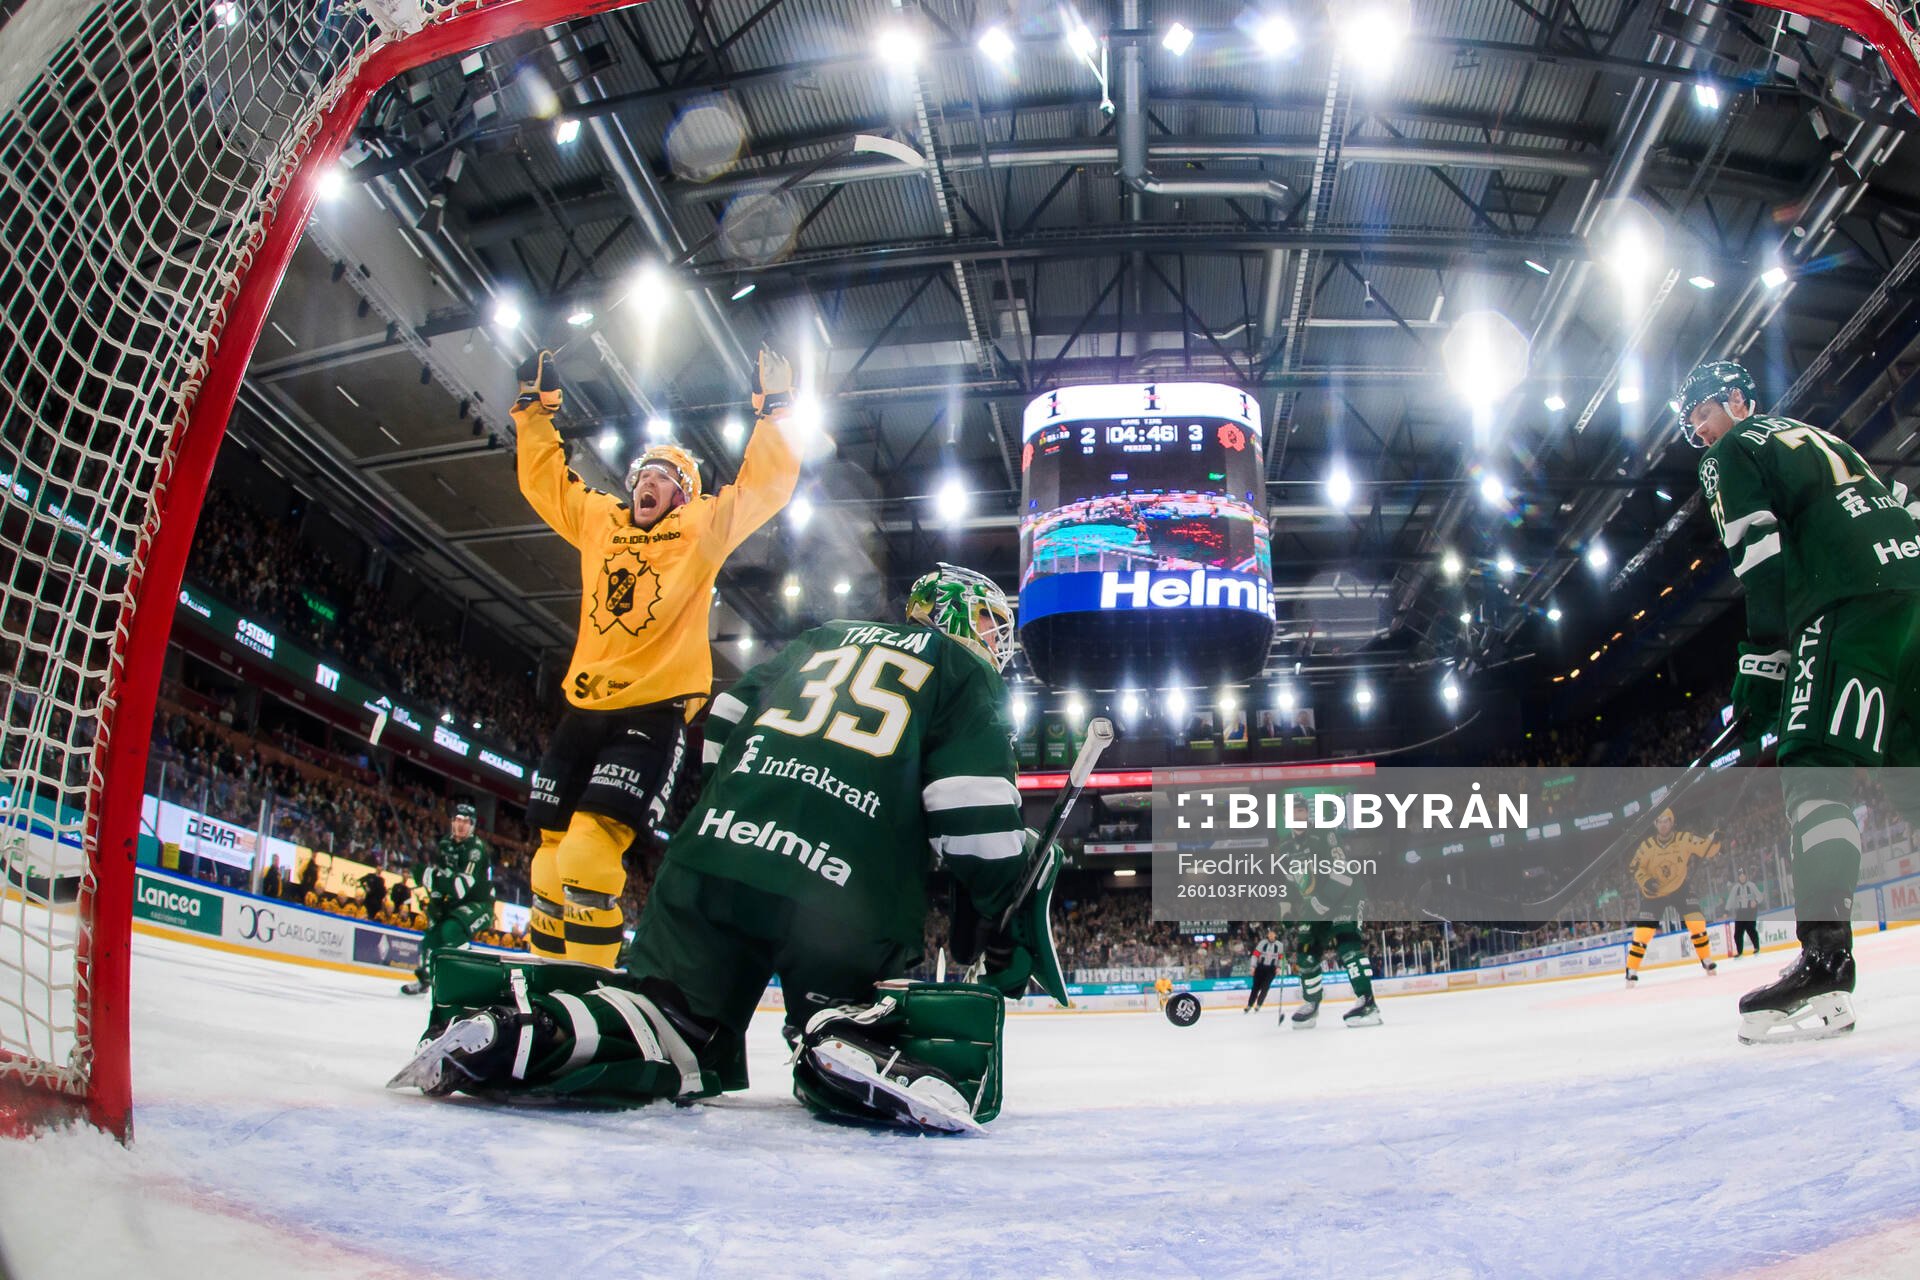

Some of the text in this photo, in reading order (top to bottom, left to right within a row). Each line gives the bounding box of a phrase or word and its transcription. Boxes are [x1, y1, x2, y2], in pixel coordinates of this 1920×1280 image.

[1080, 427, 1096, 445] 2
[1110, 425, 1174, 443] 04:46
[1188, 424, 1204, 441] 3
[245, 622, 275, 650] STENA
[754, 643, 935, 758] 35
[759, 755, 881, 818] Infrakraft
[698, 807, 852, 887] Helmia
[137, 877, 202, 917] Lancea
